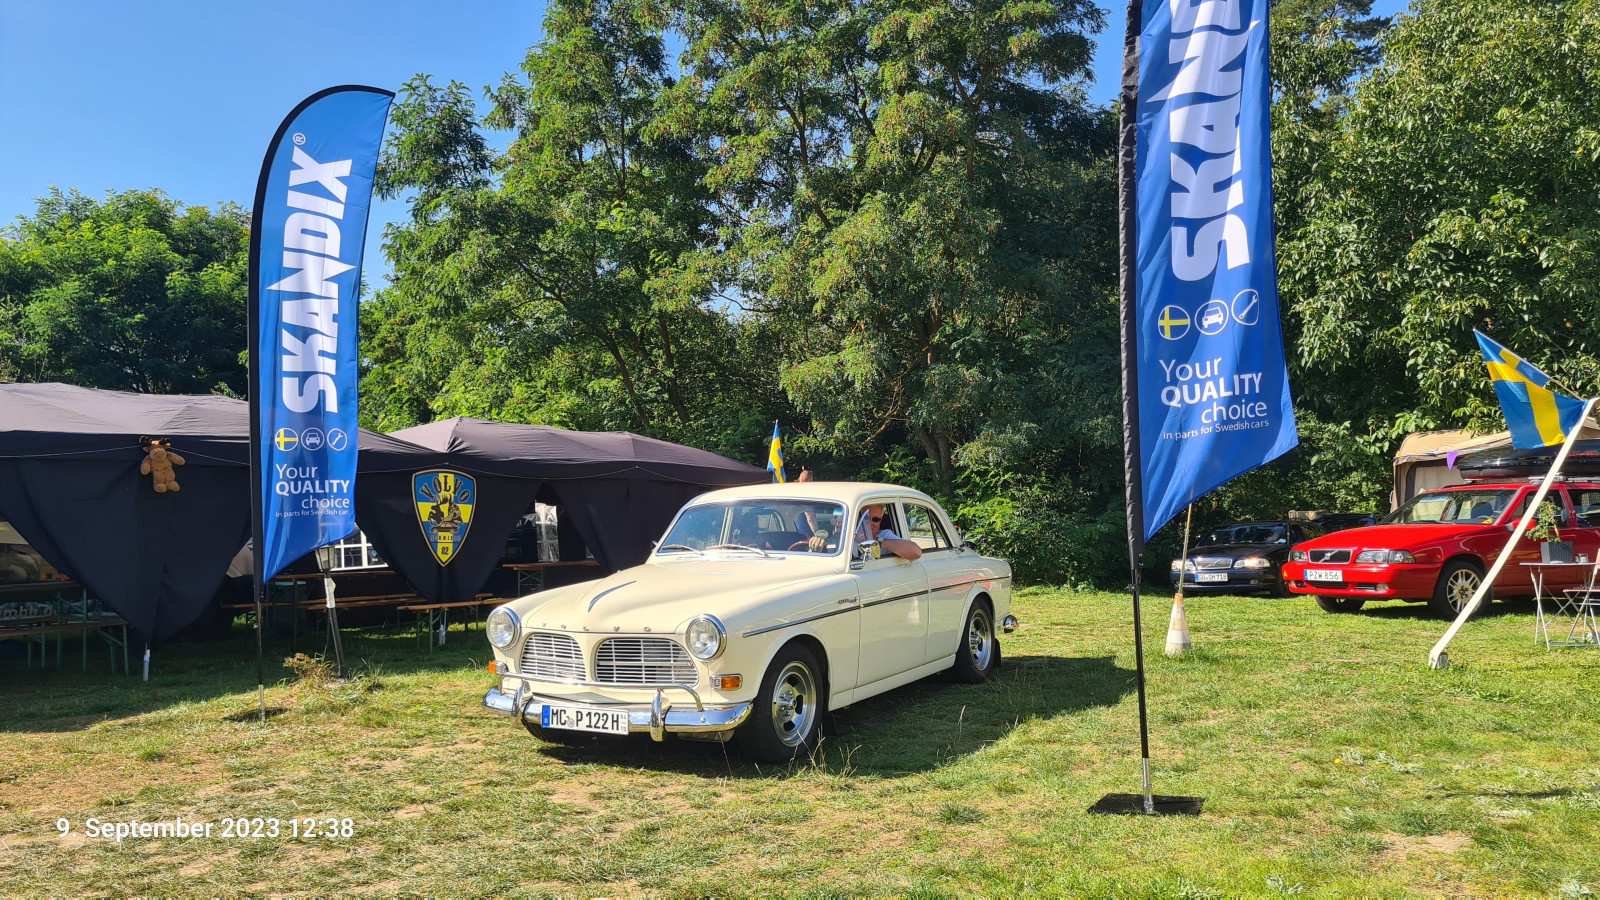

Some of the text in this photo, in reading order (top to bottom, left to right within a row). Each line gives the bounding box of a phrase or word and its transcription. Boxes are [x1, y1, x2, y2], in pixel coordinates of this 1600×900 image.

[1158, 357, 1222, 383] Your
[1160, 372, 1263, 408] QUALITY
[1201, 399, 1268, 424] choice
[1163, 419, 1270, 442] in parts for Swedish cars
[275, 463, 319, 480] Your
[275, 479, 350, 497] QUALITY
[419, 474, 471, 503] VOLVO
[301, 494, 350, 509] choice
[283, 509, 301, 519] parts
[301, 508, 310, 516] for
[551, 708, 568, 726] MC
